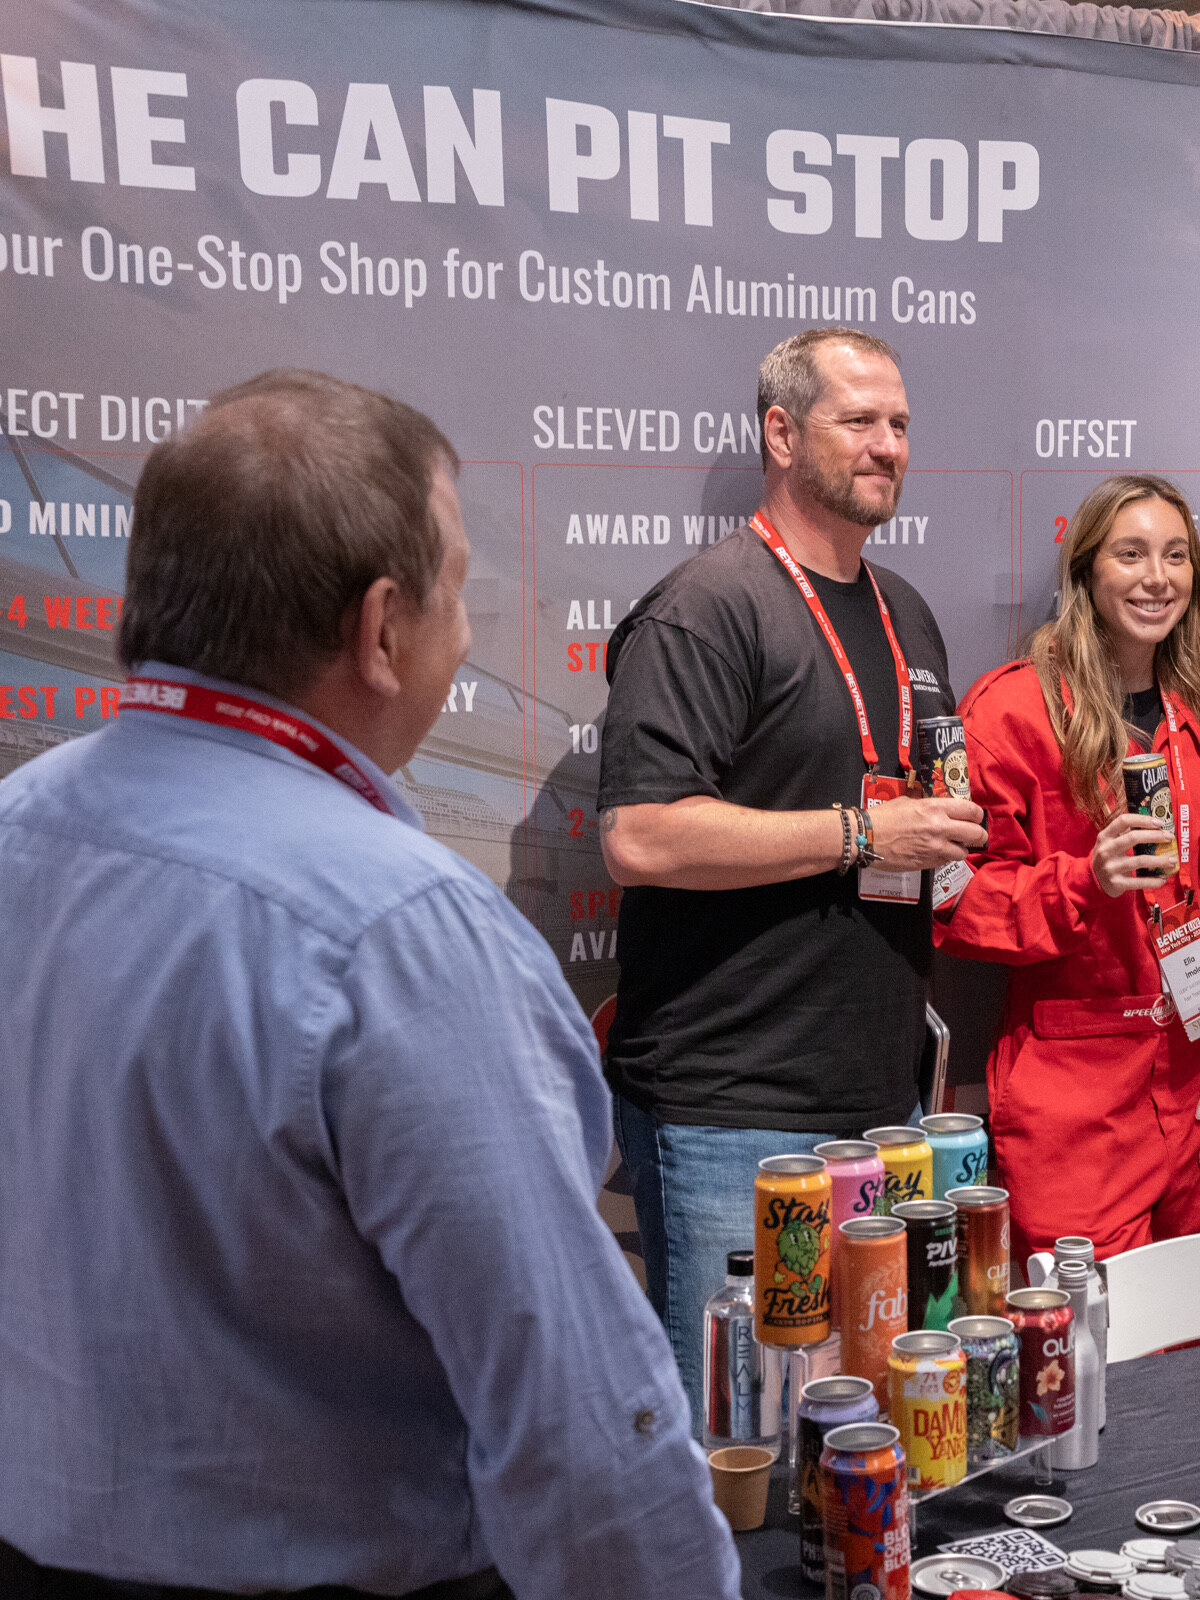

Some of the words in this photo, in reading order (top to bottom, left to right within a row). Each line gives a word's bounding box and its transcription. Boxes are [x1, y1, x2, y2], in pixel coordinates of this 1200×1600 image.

[0, 54, 196, 192] HE
[236, 78, 504, 207] CAN
[546, 97, 730, 227] PIT
[766, 128, 1040, 243] STOP
[81, 226, 302, 304] One-Stop
[320, 241, 428, 308] Shop
[443, 247, 503, 300] for
[519, 249, 671, 312] Custom
[686, 264, 877, 322] Aluminum
[891, 276, 977, 326] Cans
[0, 388, 84, 440] ECT
[534, 405, 681, 453] SLEEVED
[694, 412, 762, 455] CAN
[1035, 419, 1137, 459] OFFSET
[565, 513, 672, 546] AWARD
[775, 546, 807, 584] BEVNET
[567, 600, 617, 631] ALL
[0, 685, 59, 719] EST
[75, 687, 121, 719] PR
[441, 681, 478, 713] RY
[845, 672, 867, 717] BEVNET
[568, 724, 598, 754] 10
[901, 702, 911, 748] BEVNET
[935, 725, 966, 755] CALAVE
[568, 808, 598, 837] 2-
[1180, 820, 1190, 863] BEVNET
[1156, 924, 1188, 949] BEVNET
[1183, 955, 1196, 966] Ella
[763, 1196, 831, 1237] Stay
[925, 1237, 957, 1261] PIV
[987, 1262, 1010, 1280] CLE
[884, 1524, 910, 1546] BLO
